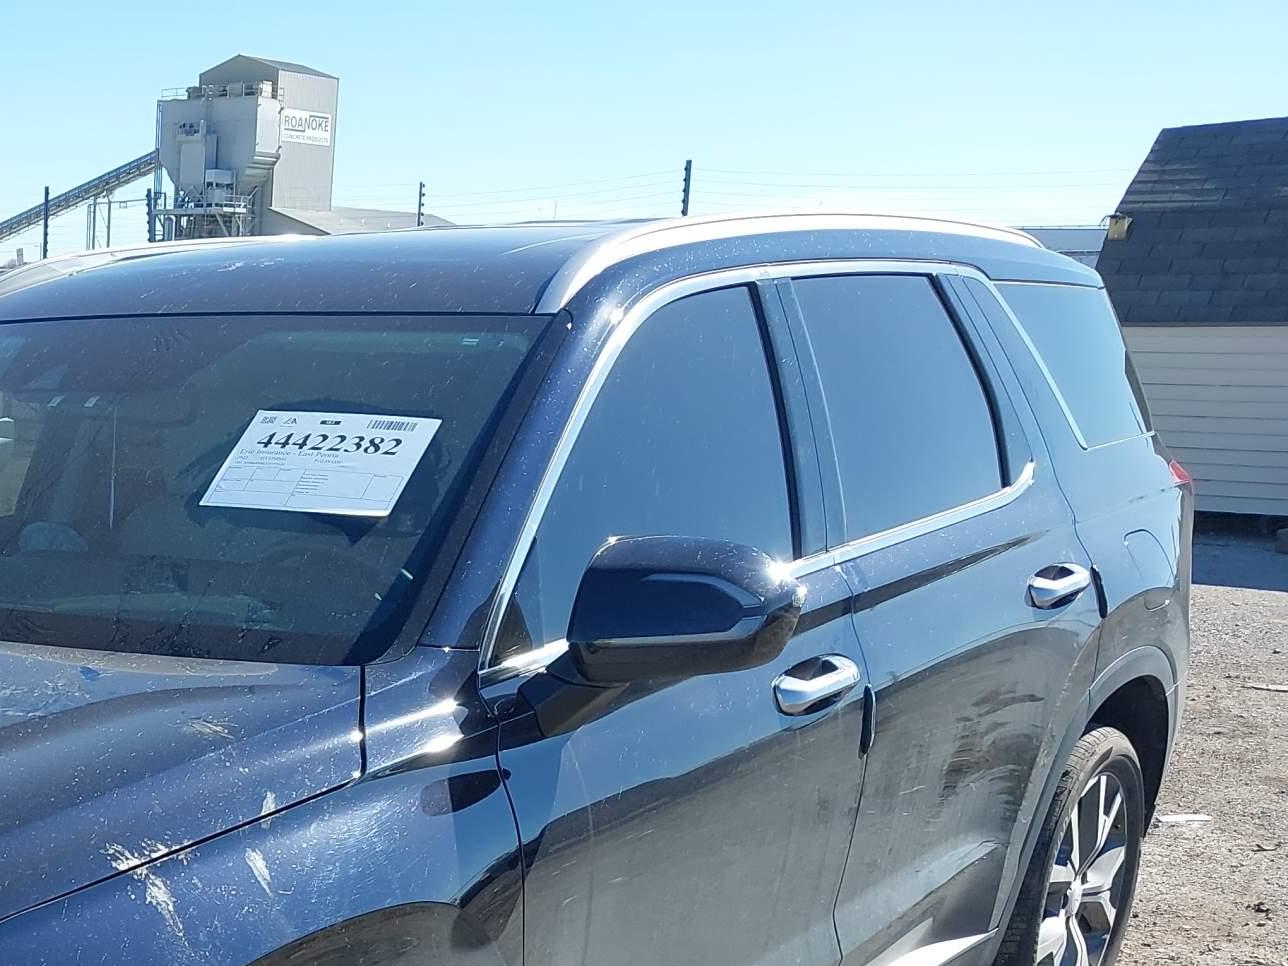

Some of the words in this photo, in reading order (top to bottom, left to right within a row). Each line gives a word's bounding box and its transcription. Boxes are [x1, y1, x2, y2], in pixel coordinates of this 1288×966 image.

[284, 115, 329, 132] ROANOKE
[256, 430, 403, 456] 44422382
[256, 448, 292, 456] Insurance
